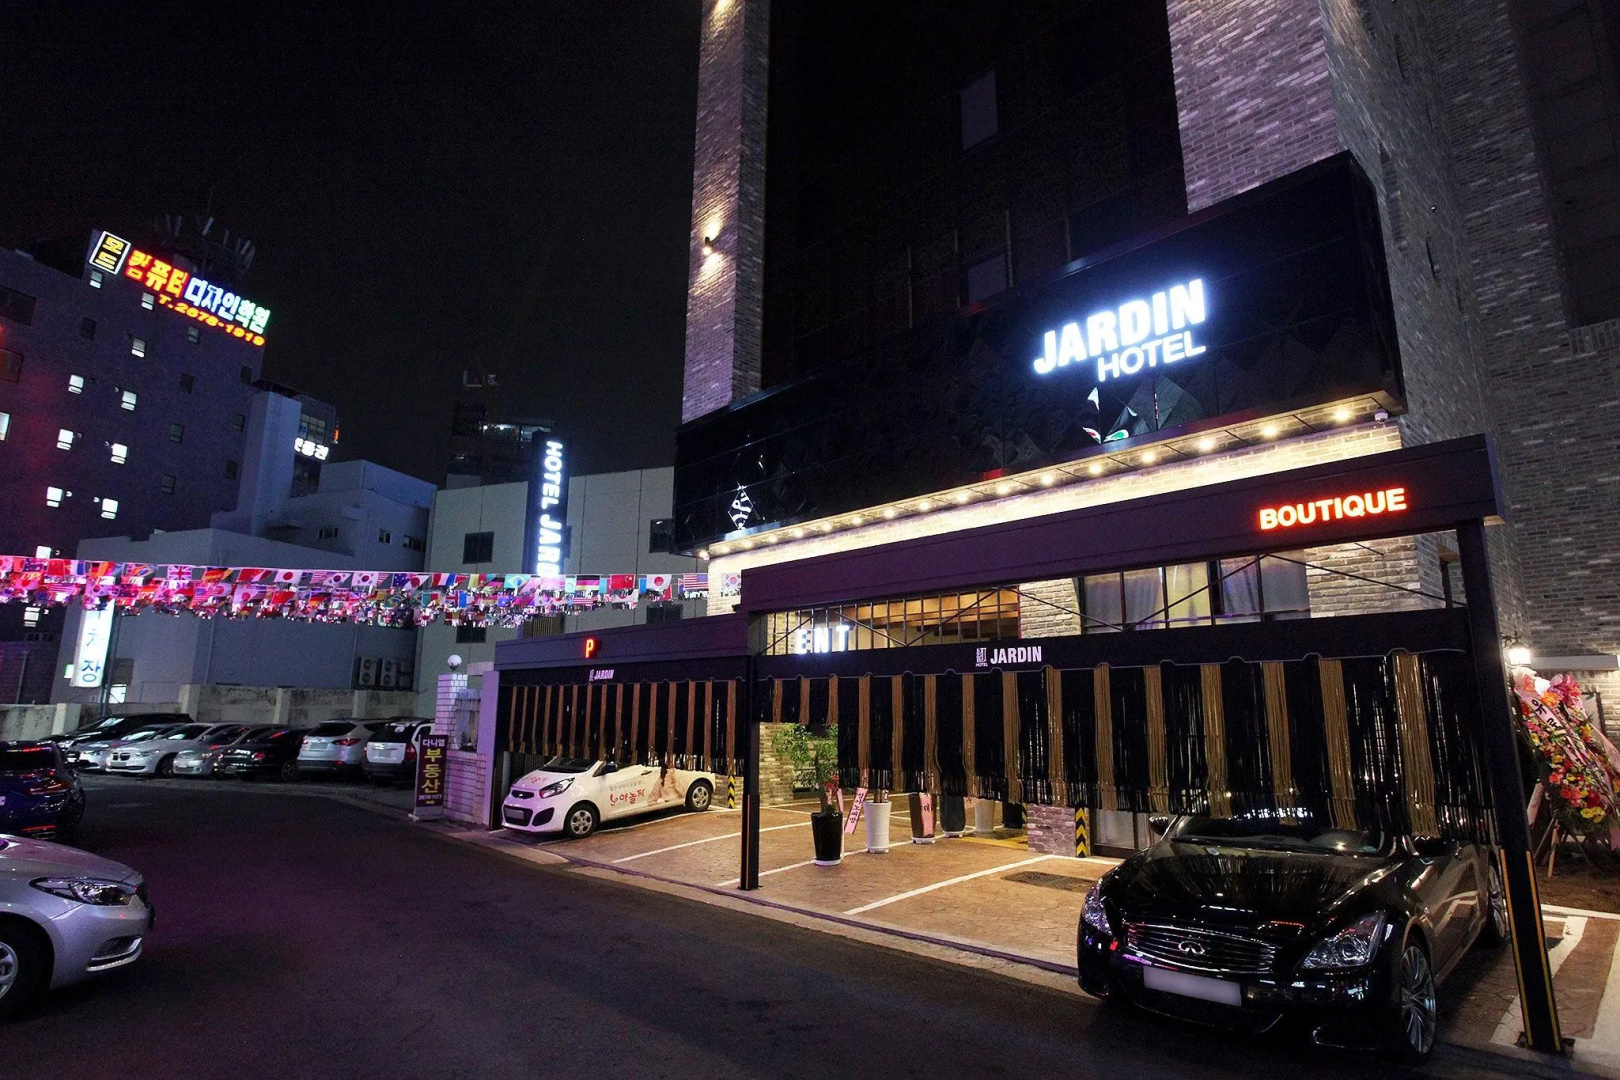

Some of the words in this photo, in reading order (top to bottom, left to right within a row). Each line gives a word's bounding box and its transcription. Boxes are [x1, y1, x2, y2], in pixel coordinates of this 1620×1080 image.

[1033, 278, 1206, 374] JARDIN
[1097, 330, 1206, 382] HOTEL
[541, 440, 563, 510] HOTEL
[1259, 488, 1407, 530] BOUTIQUE
[585, 638, 594, 658] P
[990, 646, 1042, 664] JARDIN
[421, 748, 442, 794] 부동산
